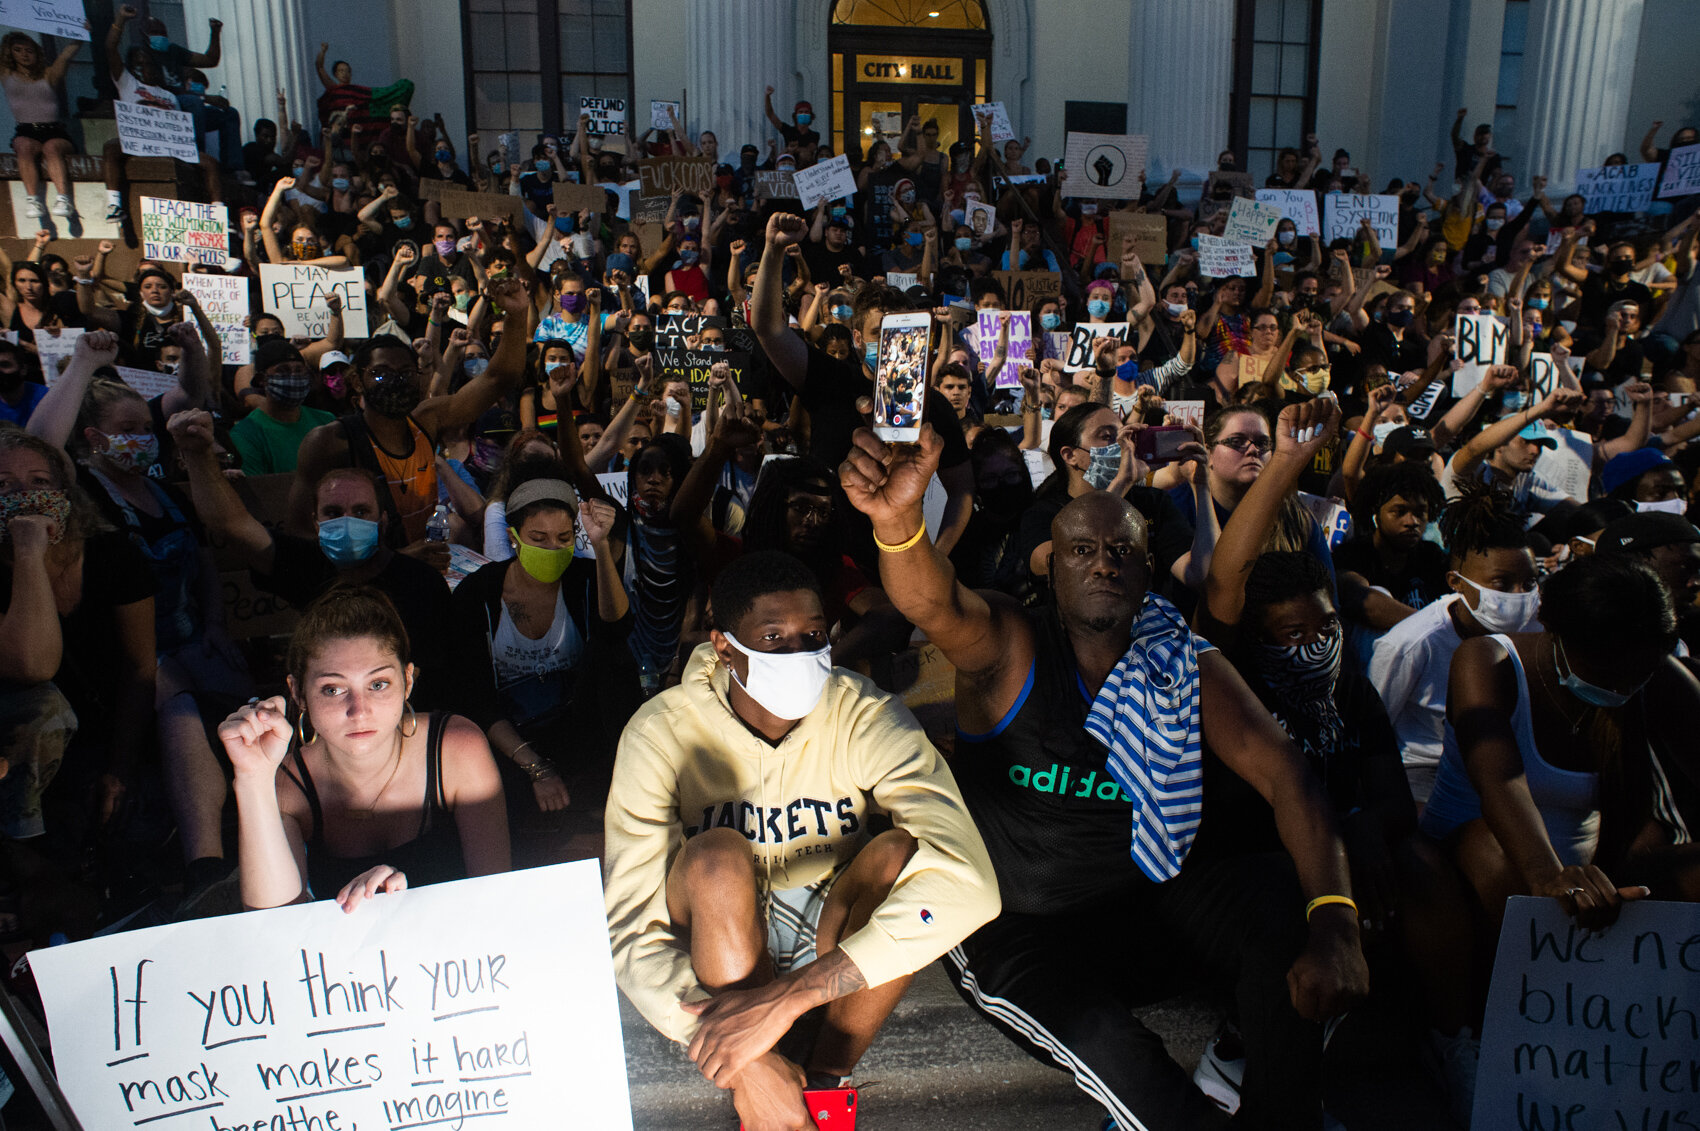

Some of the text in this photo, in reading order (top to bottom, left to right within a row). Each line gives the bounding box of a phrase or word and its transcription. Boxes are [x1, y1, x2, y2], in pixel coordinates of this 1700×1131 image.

[864, 62, 954, 79] CITY HALL
[117, 102, 132, 112] YOU
[165, 112, 180, 121] FIX
[182, 114, 189, 122] A
[581, 98, 625, 111] DEFUND
[590, 110, 608, 118] THE
[118, 113, 151, 127] SYSTEM
[154, 121, 182, 132] ROOTED
[586, 119, 625, 135] OLICE
[124, 140, 138, 151] WE
[143, 144, 160, 154] ARE
[681, 162, 712, 192] COPS
[757, 171, 786, 183] WHITE
[1593, 164, 1639, 180] ACAB
[1577, 181, 1615, 195] BLACK
[1664, 181, 1679, 191] SAY
[1282, 190, 1303, 203] You
[1335, 194, 1381, 209] END
[149, 198, 216, 220] TEACH THE
[168, 215, 224, 233] WILMINGTON
[144, 227, 163, 242] RACE
[189, 232, 227, 250] MASSACRE
[145, 243, 158, 258] IN
[163, 245, 182, 260] OUR
[295, 267, 329, 280] MAY
[1210, 267, 1242, 275] HUMANITY
[185, 276, 238, 289] WHEN THE
[1025, 277, 1058, 292] JUSTICE
[190, 287, 240, 300] POWER OF
[273, 281, 363, 311] PEACE
[207, 313, 241, 324] GREATER
[297, 312, 329, 321] BE WI
[656, 314, 707, 334] LACK
[979, 313, 1030, 337] HAPY
[655, 334, 689, 349] LIV
[1459, 317, 1509, 365] BLM
[223, 352, 240, 361] ACE
[656, 350, 679, 367] We
[684, 352, 712, 367] Stand
[1245, 357, 1262, 375] BL
[687, 797, 859, 844] JACKETS
[796, 843, 833, 857] TECH
[109, 958, 153, 1051] If
[187, 978, 275, 1047] you
[299, 948, 403, 1017] think
[1519, 974, 1698, 1041] black
[119, 1063, 230, 1113] mask
[260, 1048, 383, 1091] makes
[411, 1038, 438, 1075] it
